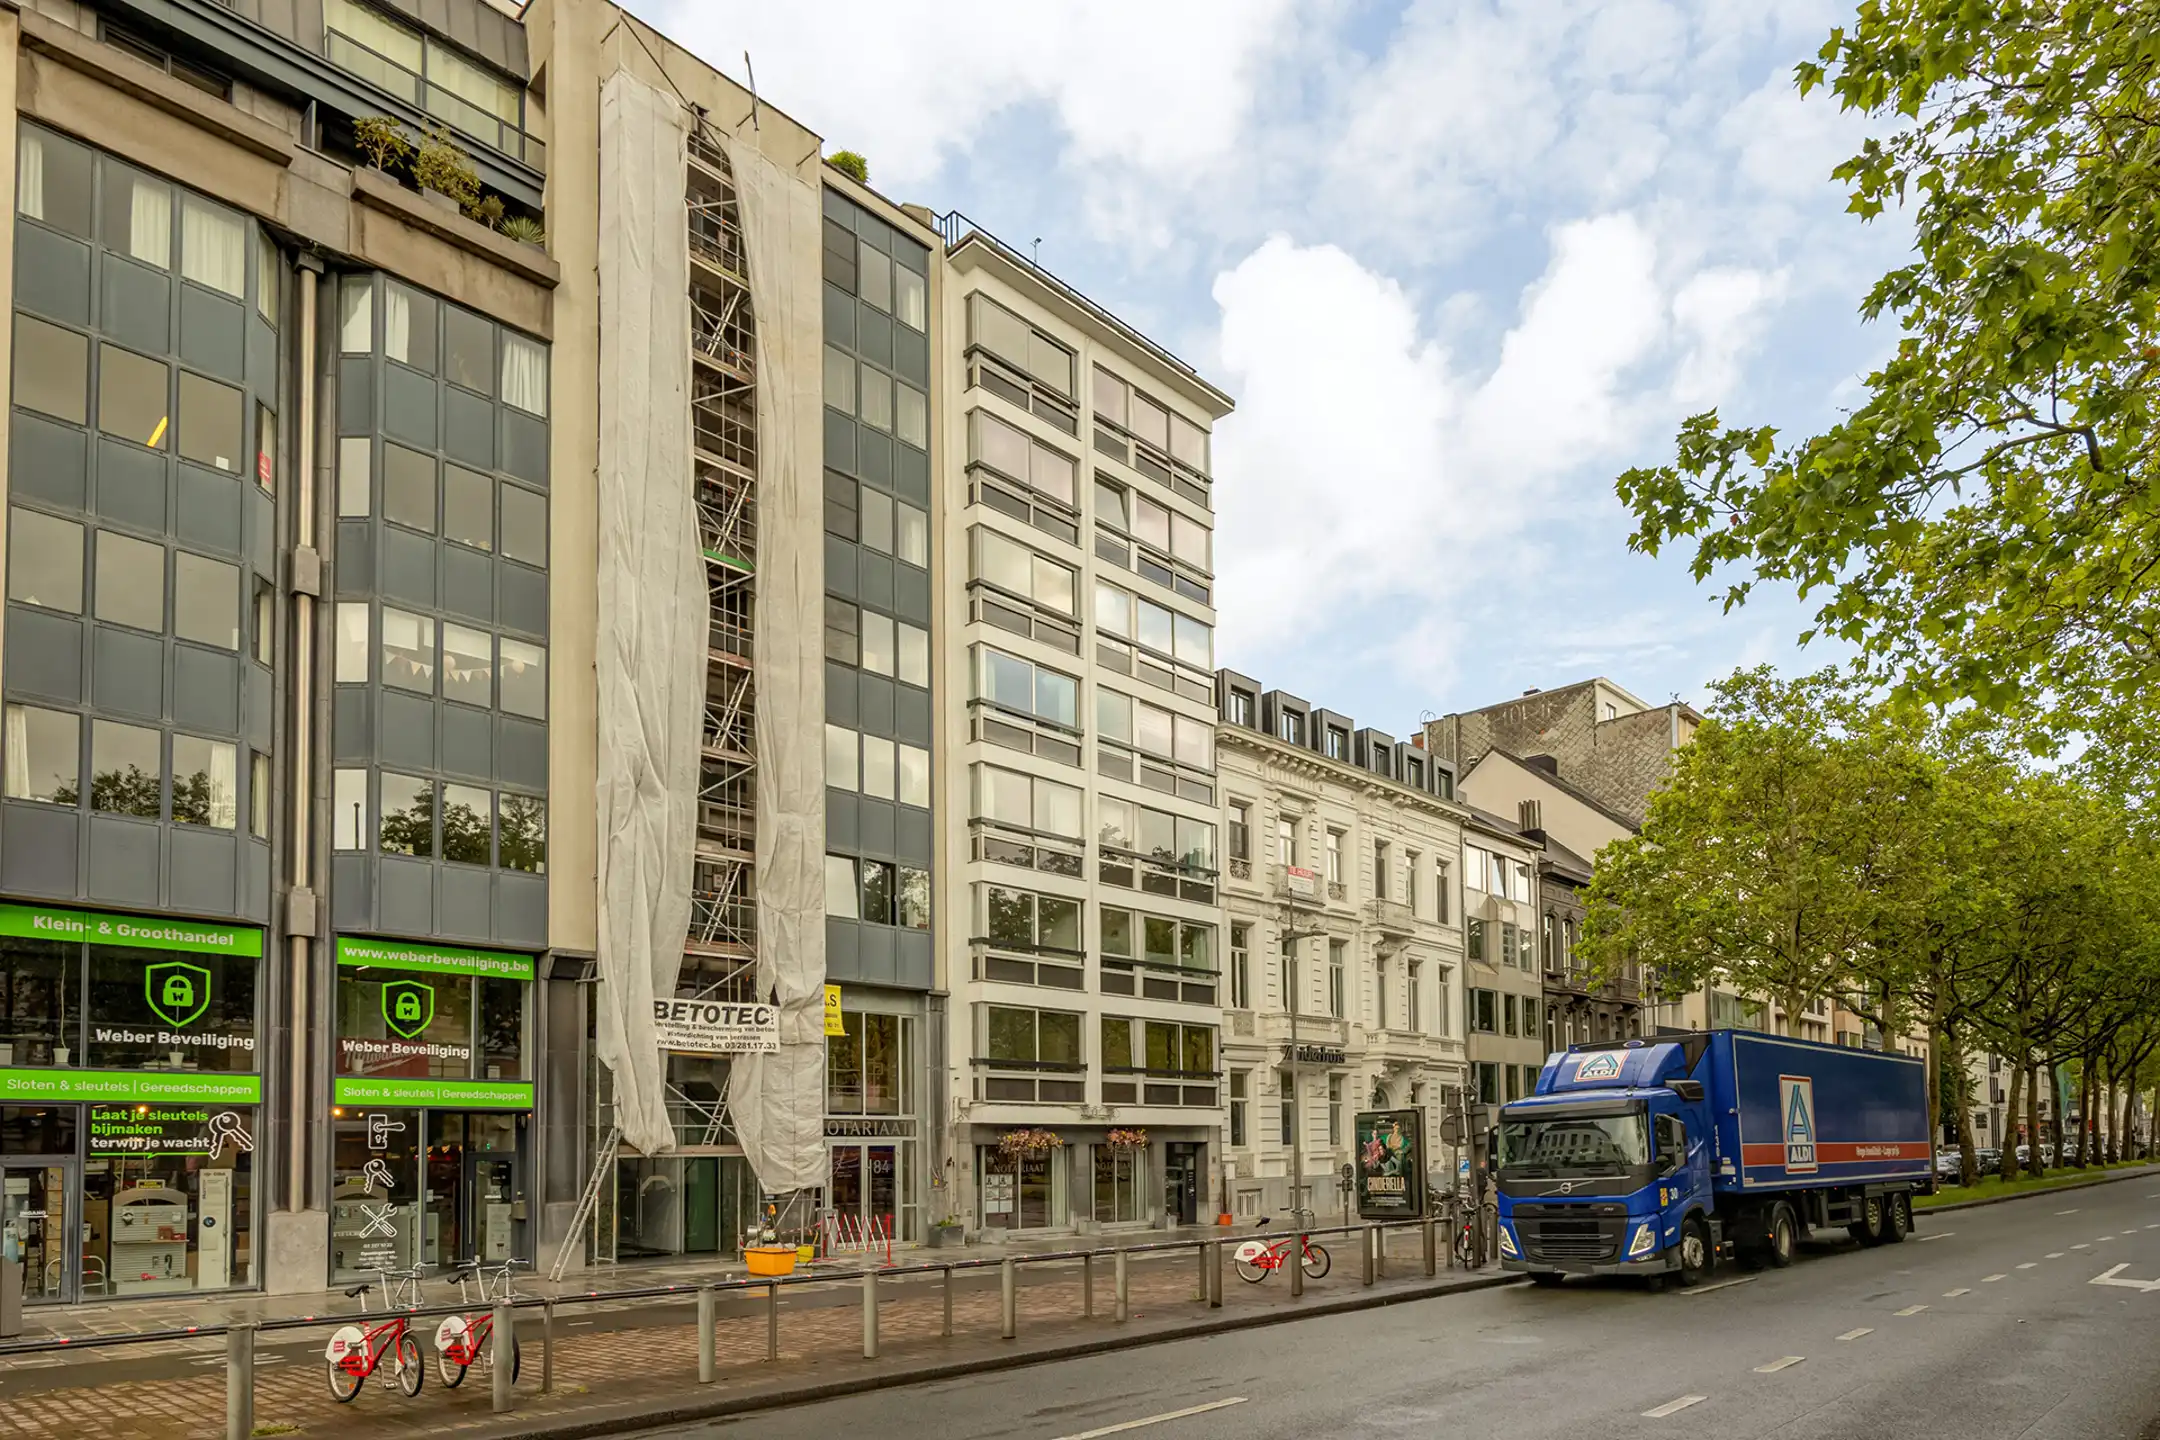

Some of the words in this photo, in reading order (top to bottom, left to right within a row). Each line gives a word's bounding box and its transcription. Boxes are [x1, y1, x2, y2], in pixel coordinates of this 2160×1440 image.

[33, 915, 92, 932] Klein-
[97, 923, 113, 935] &
[116, 924, 234, 946] Groothandel
[344, 946, 529, 972] www.weberbeveiliging.be
[653, 1001, 770, 1026] BETOTEC
[96, 1028, 154, 1044] Weber
[158, 1031, 255, 1050] Beveiliging
[341, 1040, 390, 1053] Weber
[391, 1042, 470, 1059] Beveiliging
[1583, 1069, 1614, 1077] ALDI
[7, 1078, 55, 1091] Sloten
[60, 1079, 70, 1091] &
[75, 1080, 130, 1092] sleutels
[140, 1082, 252, 1096] Gereedschappen
[343, 1087, 380, 1098] Sloten
[383, 1087, 391, 1098] &
[393, 1088, 435, 1099] sleutels
[442, 1089, 527, 1102] Gereedschappen
[91, 1109, 129, 1121] Laat
[130, 1110, 146, 1124] je
[148, 1110, 209, 1122] sleutels
[91, 1124, 163, 1137] bijmaken
[828, 1120, 909, 1136] OTARIAAT
[145, 1137, 160, 1150] je
[163, 1136, 210, 1149] wacht
[1790, 1146, 1813, 1163] ALDI
[1368, 1176, 1406, 1191] CINDERELLA
